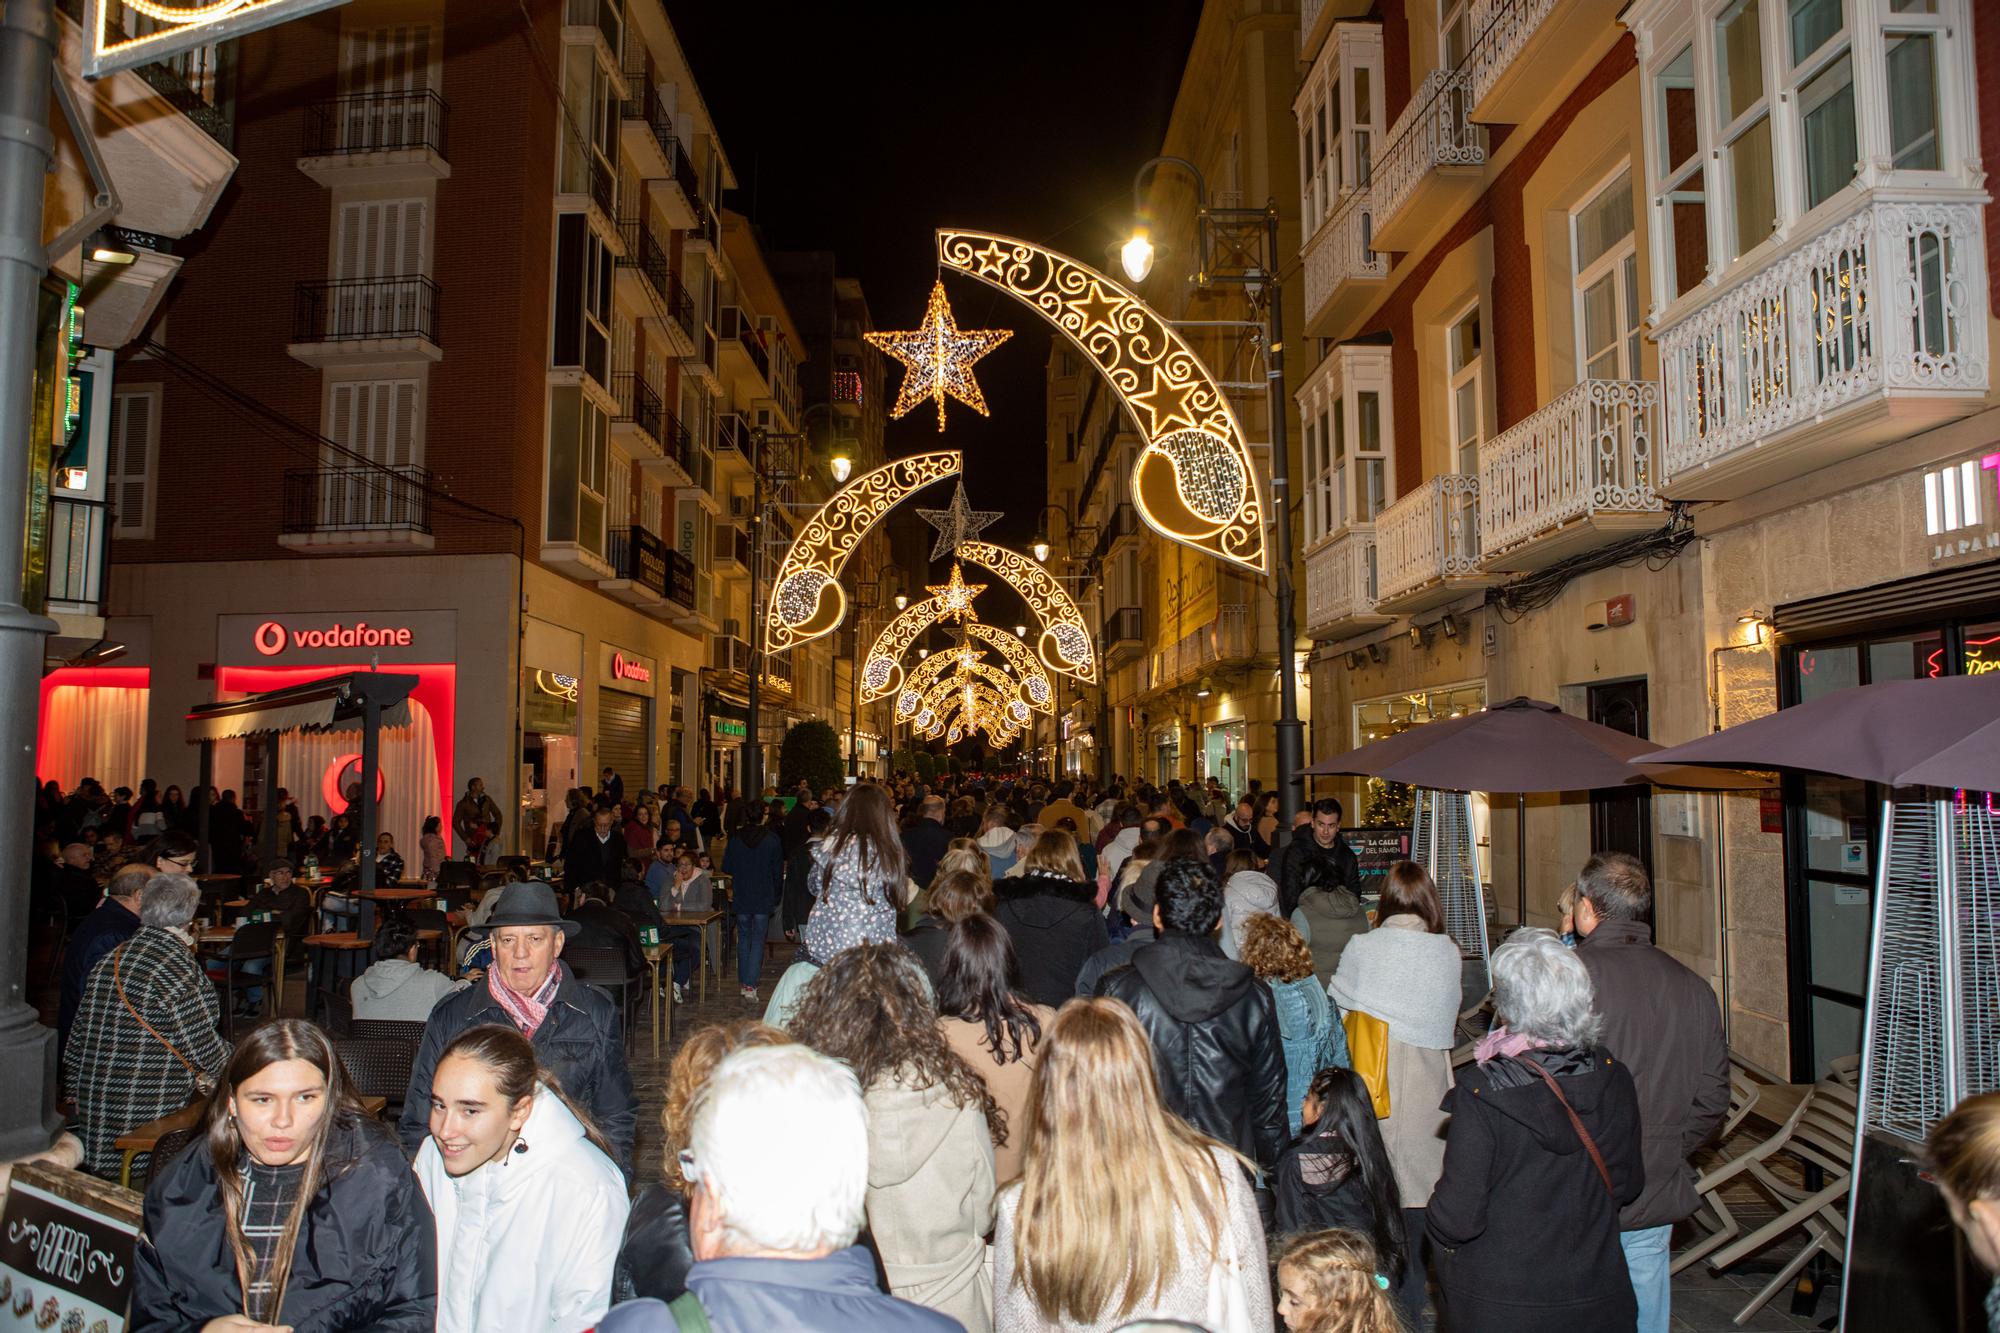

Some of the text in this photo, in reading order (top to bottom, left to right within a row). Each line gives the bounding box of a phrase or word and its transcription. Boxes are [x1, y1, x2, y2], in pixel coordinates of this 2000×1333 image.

[293, 623, 412, 648] vodafone
[623, 662, 649, 682] vodafone
[37, 1221, 90, 1284] GOFRES
